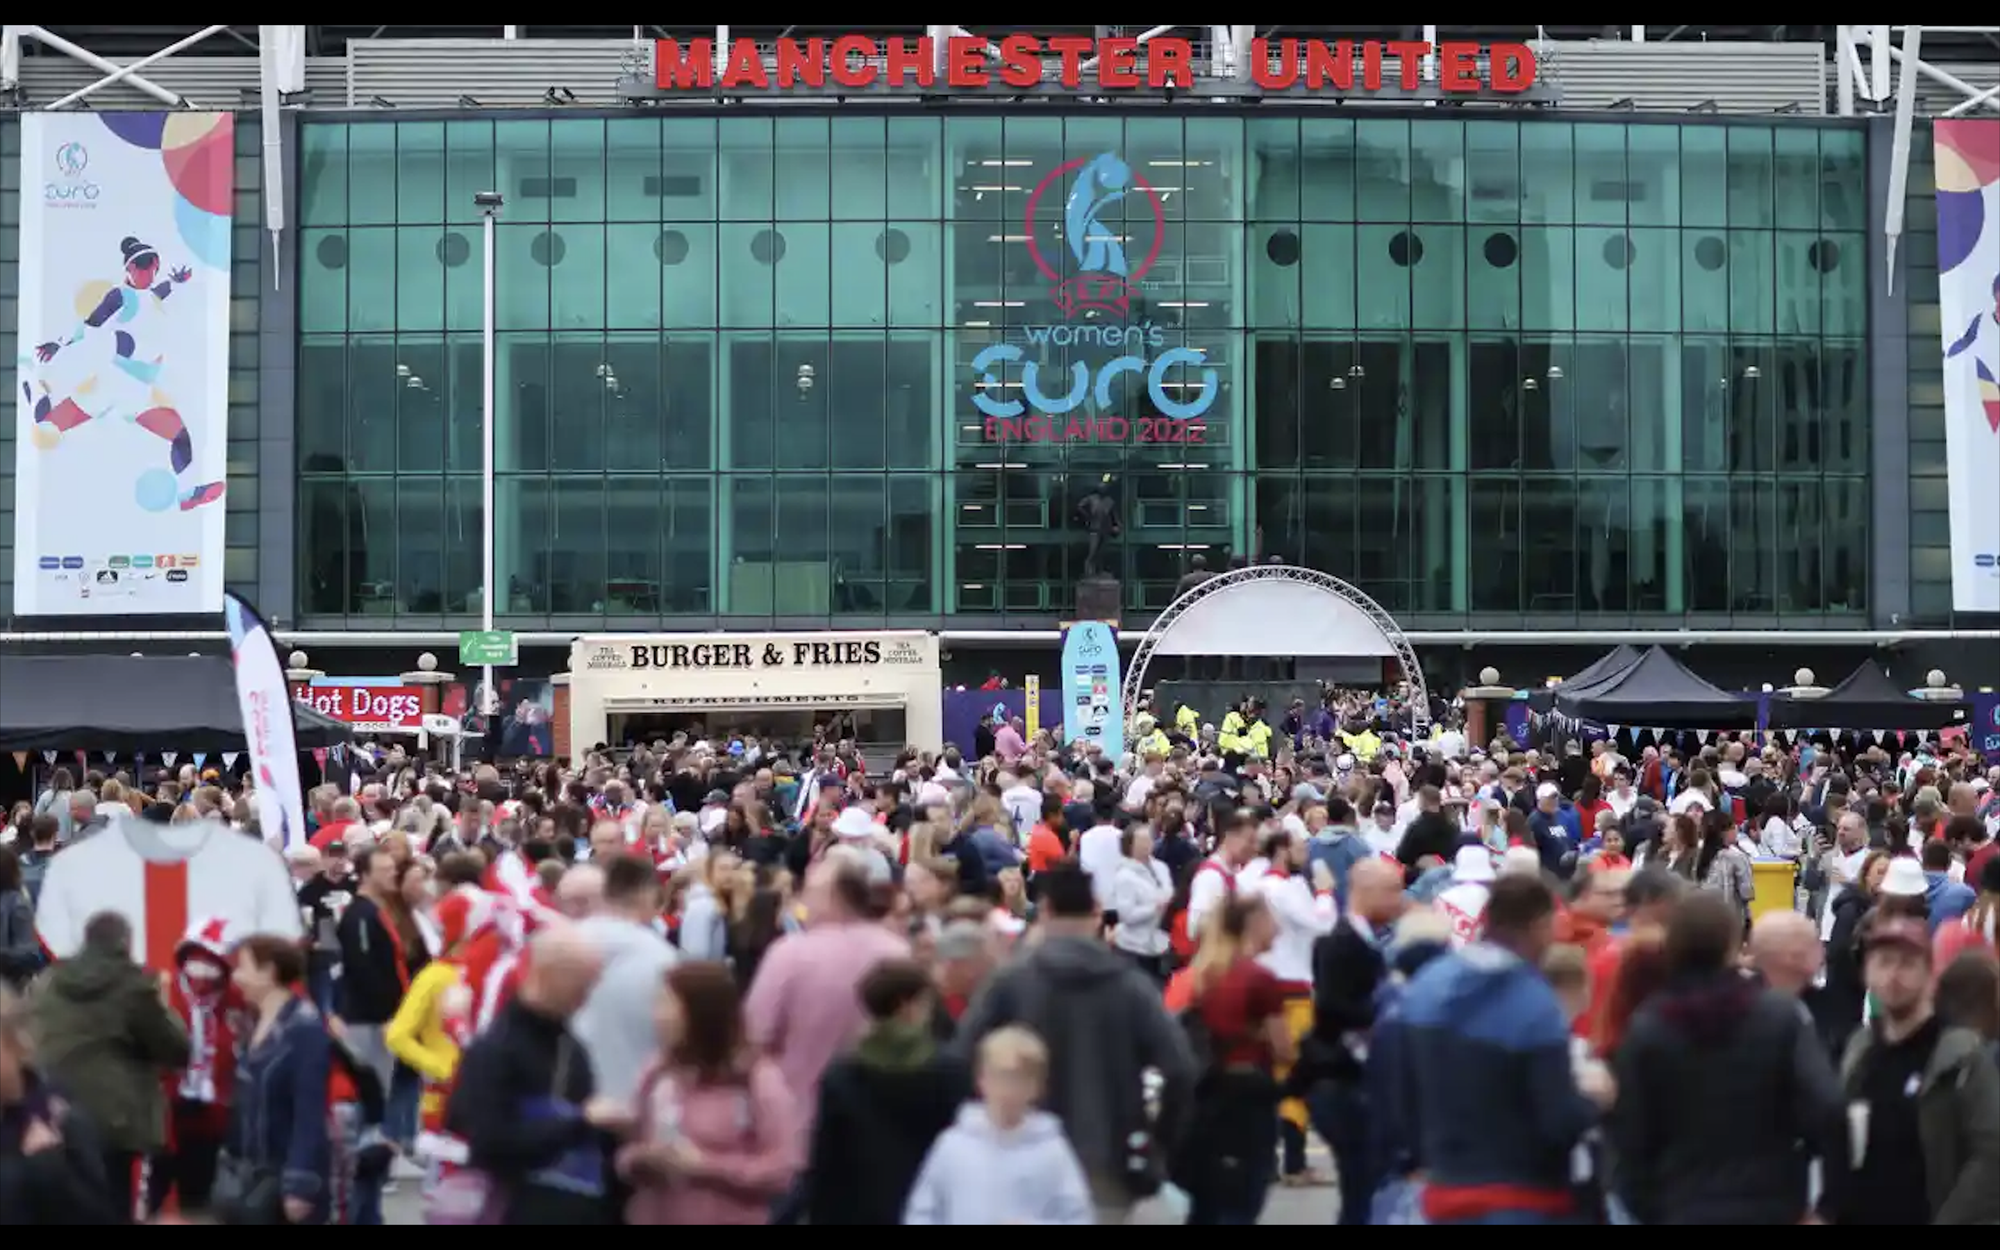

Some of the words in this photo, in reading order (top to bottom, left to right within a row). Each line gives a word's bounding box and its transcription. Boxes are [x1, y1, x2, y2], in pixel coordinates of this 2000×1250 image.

[656, 36, 1194, 89] MANCHESTER
[1252, 38, 1536, 92] UNITED
[1024, 322, 1164, 346] women's
[985, 417, 1130, 442] ENGLAND
[1135, 417, 1207, 442] 2022
[631, 645, 752, 668] BURGER
[762, 643, 784, 665] &
[793, 641, 881, 664] FRIES
[296, 687, 342, 715] Hot
[353, 688, 420, 722] Dogs
[651, 694, 860, 705] REFRESHMENTS
